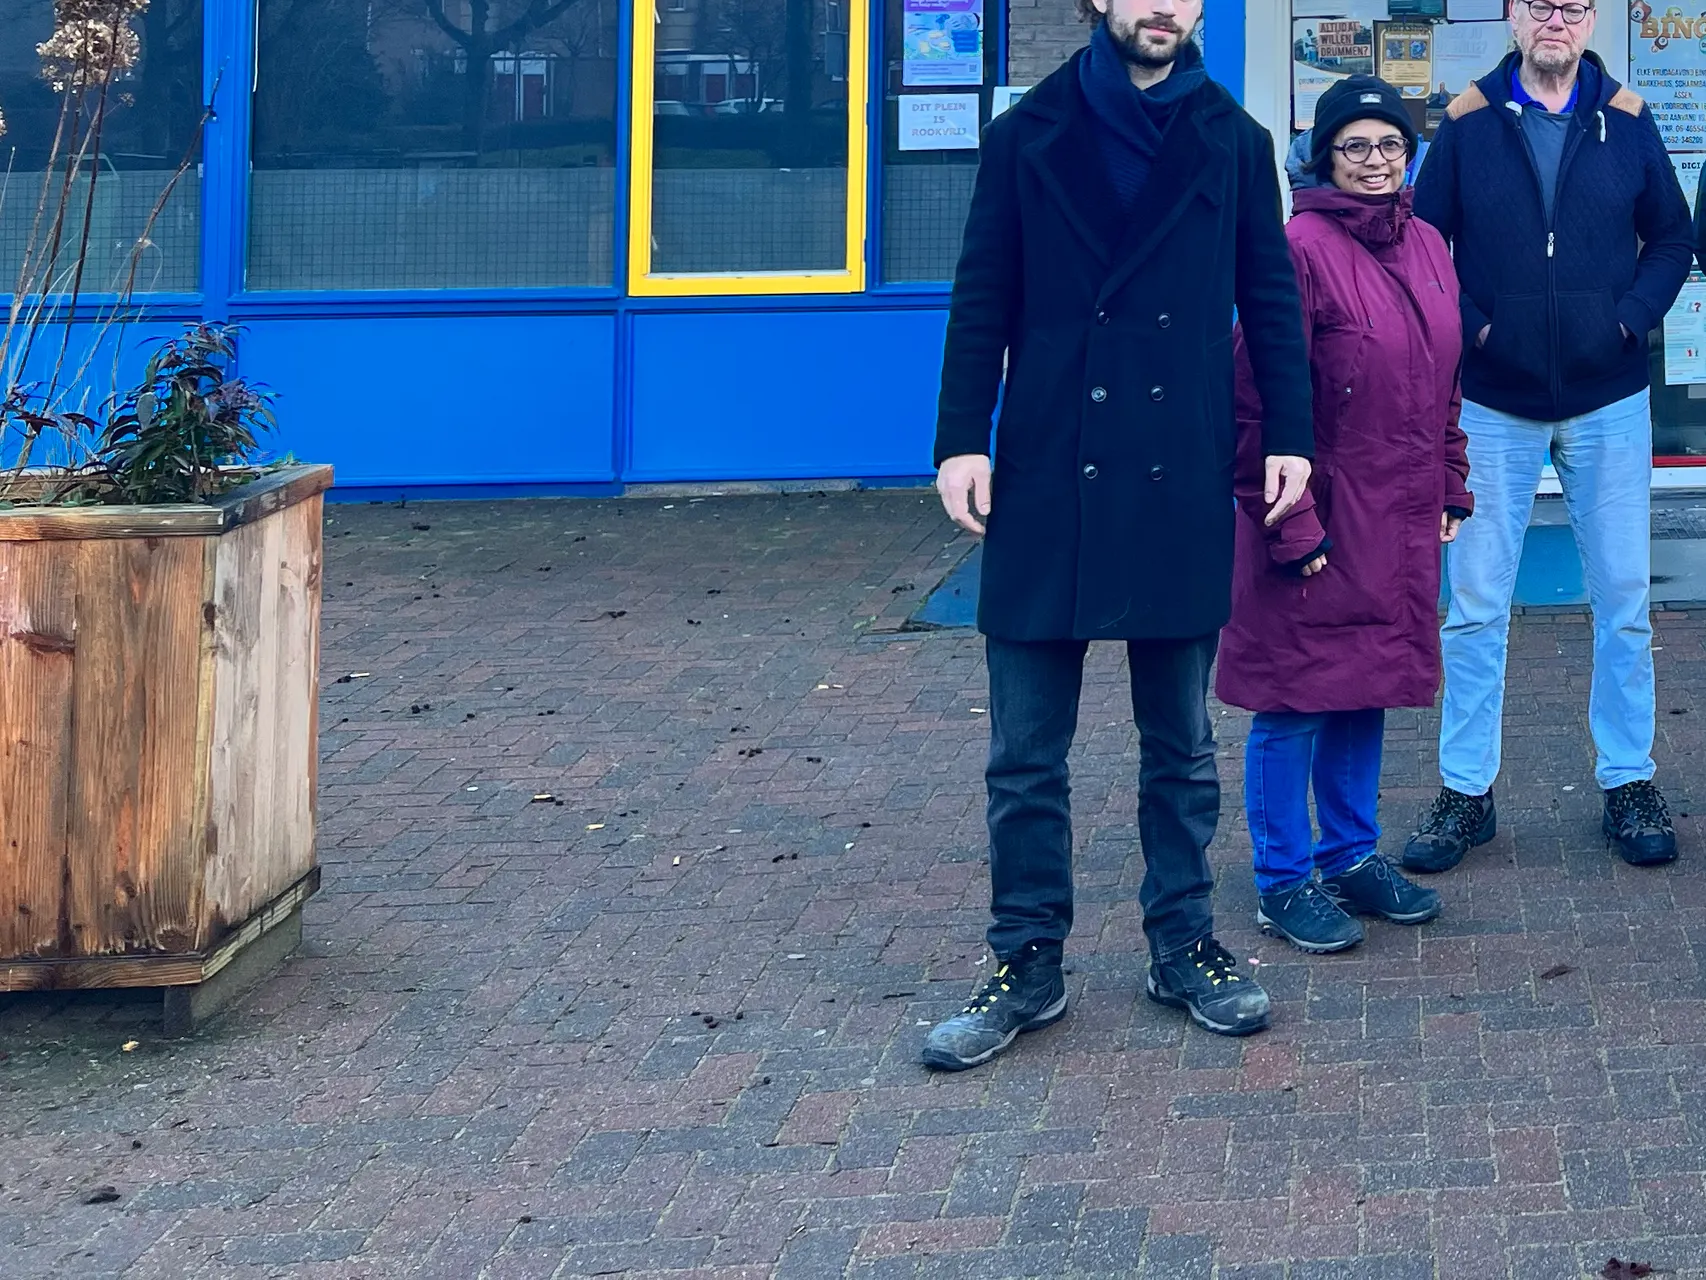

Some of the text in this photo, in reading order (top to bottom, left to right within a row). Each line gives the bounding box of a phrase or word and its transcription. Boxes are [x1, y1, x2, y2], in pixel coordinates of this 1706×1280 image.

[1320, 22, 1357, 32] ALTIJD AL
[1320, 34, 1352, 44] WILLEN
[1320, 46, 1369, 56] DRUMMEN?
[1637, 69, 1651, 77] ELKE
[912, 103, 967, 112] DIT PLEIN
[933, 116, 945, 124] IS
[912, 128, 967, 136] ROOKVRIJ
